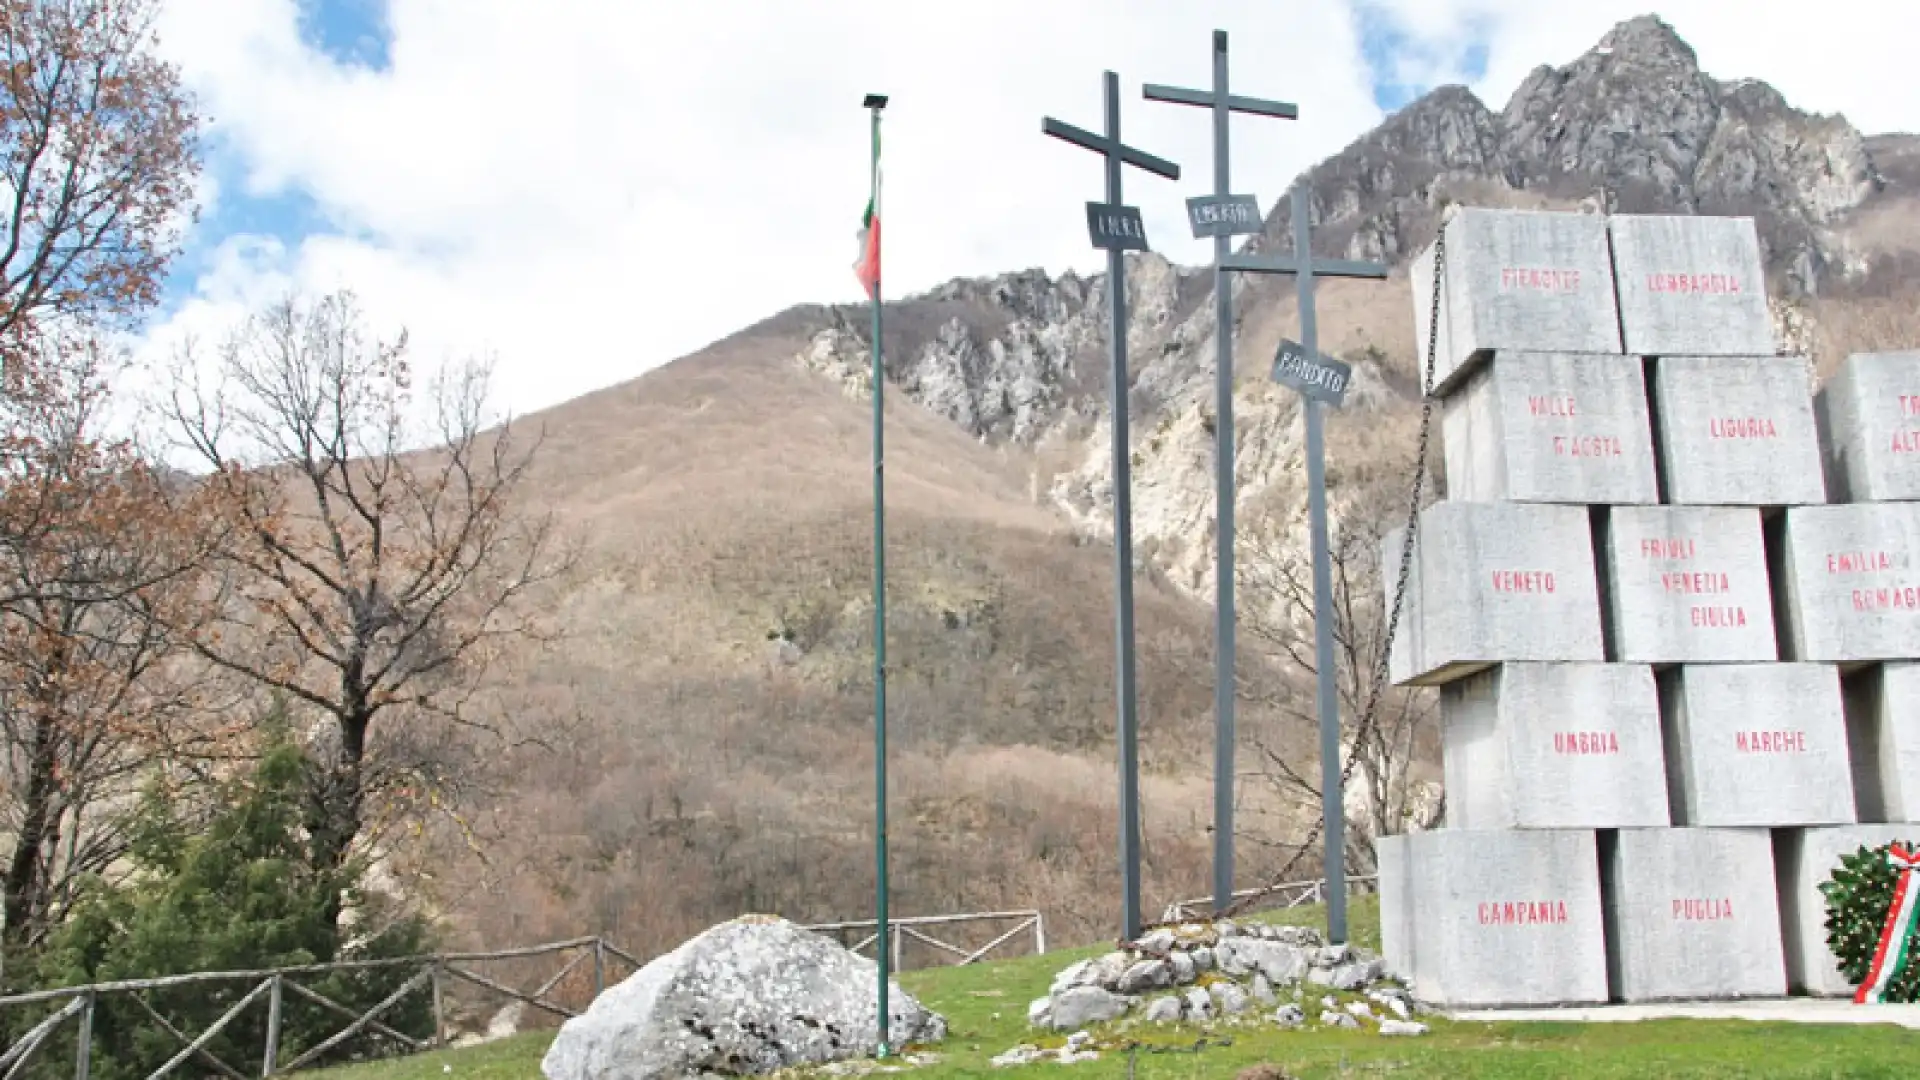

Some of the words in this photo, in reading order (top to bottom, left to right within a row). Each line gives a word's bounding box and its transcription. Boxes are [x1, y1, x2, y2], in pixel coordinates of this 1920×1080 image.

[1501, 267, 1582, 291] PIEMONTE
[1645, 272, 1742, 295] LOMBARDIA
[1528, 395, 1577, 417] VALLE
[1710, 417, 1778, 440] LIGURIA
[1640, 538, 1696, 561] FRIULI
[1827, 551, 1890, 575] EMILIA
[1492, 571, 1556, 594] VENETO
[1661, 571, 1730, 594] VENEZIA
[1852, 587, 1920, 611] ROMAG
[1691, 606, 1746, 628] GIULIA
[1554, 731, 1619, 754] UMBRIA
[1736, 730, 1806, 753] MARCHE
[1478, 900, 1568, 925] CAMPANIA
[1672, 898, 1733, 920] PUGLIA
